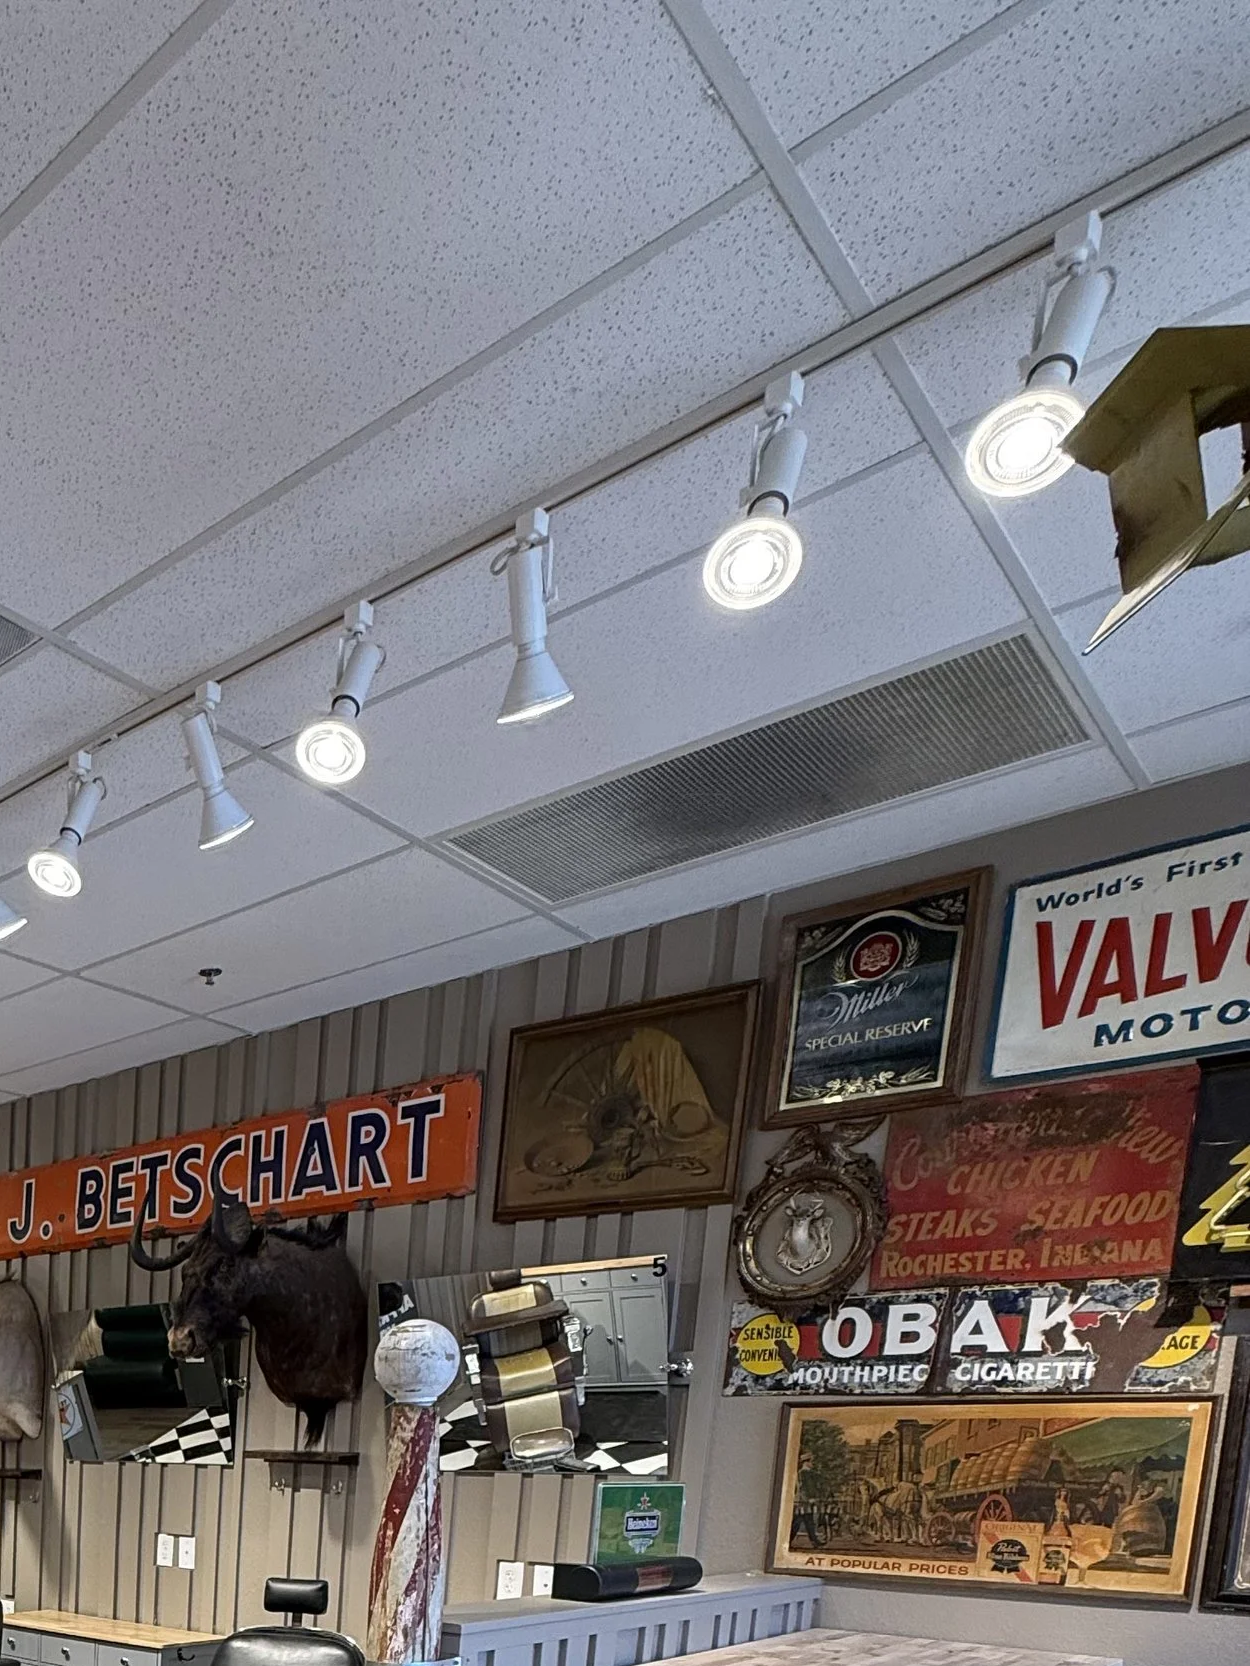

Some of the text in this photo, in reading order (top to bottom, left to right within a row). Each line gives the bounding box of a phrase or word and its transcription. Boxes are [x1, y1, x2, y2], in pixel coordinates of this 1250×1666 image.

[1036, 851, 1243, 912] World's First
[1036, 899, 1250, 1030] VALV
[816, 974, 919, 1030] Miller
[1094, 999, 1250, 1048] MOTO
[805, 1017, 933, 1051] SPECIAL RESERVE
[8, 1179, 53, 1244] J.
[75, 1093, 446, 1235] BETSCHART
[947, 1151, 1100, 1196] CHICKEN
[884, 1189, 1176, 1245] STEAKS SEAFOOD
[652, 1256, 667, 1277] 5
[742, 1325, 794, 1341] SENSIBLE
[822, 1297, 1089, 1358] OBAK
[1161, 1335, 1200, 1350] AGE
[739, 1348, 782, 1362] CONVENI
[787, 1364, 930, 1385] MOUTHPIEC
[805, 1556, 970, 1576] AT POPULAR PRICES
